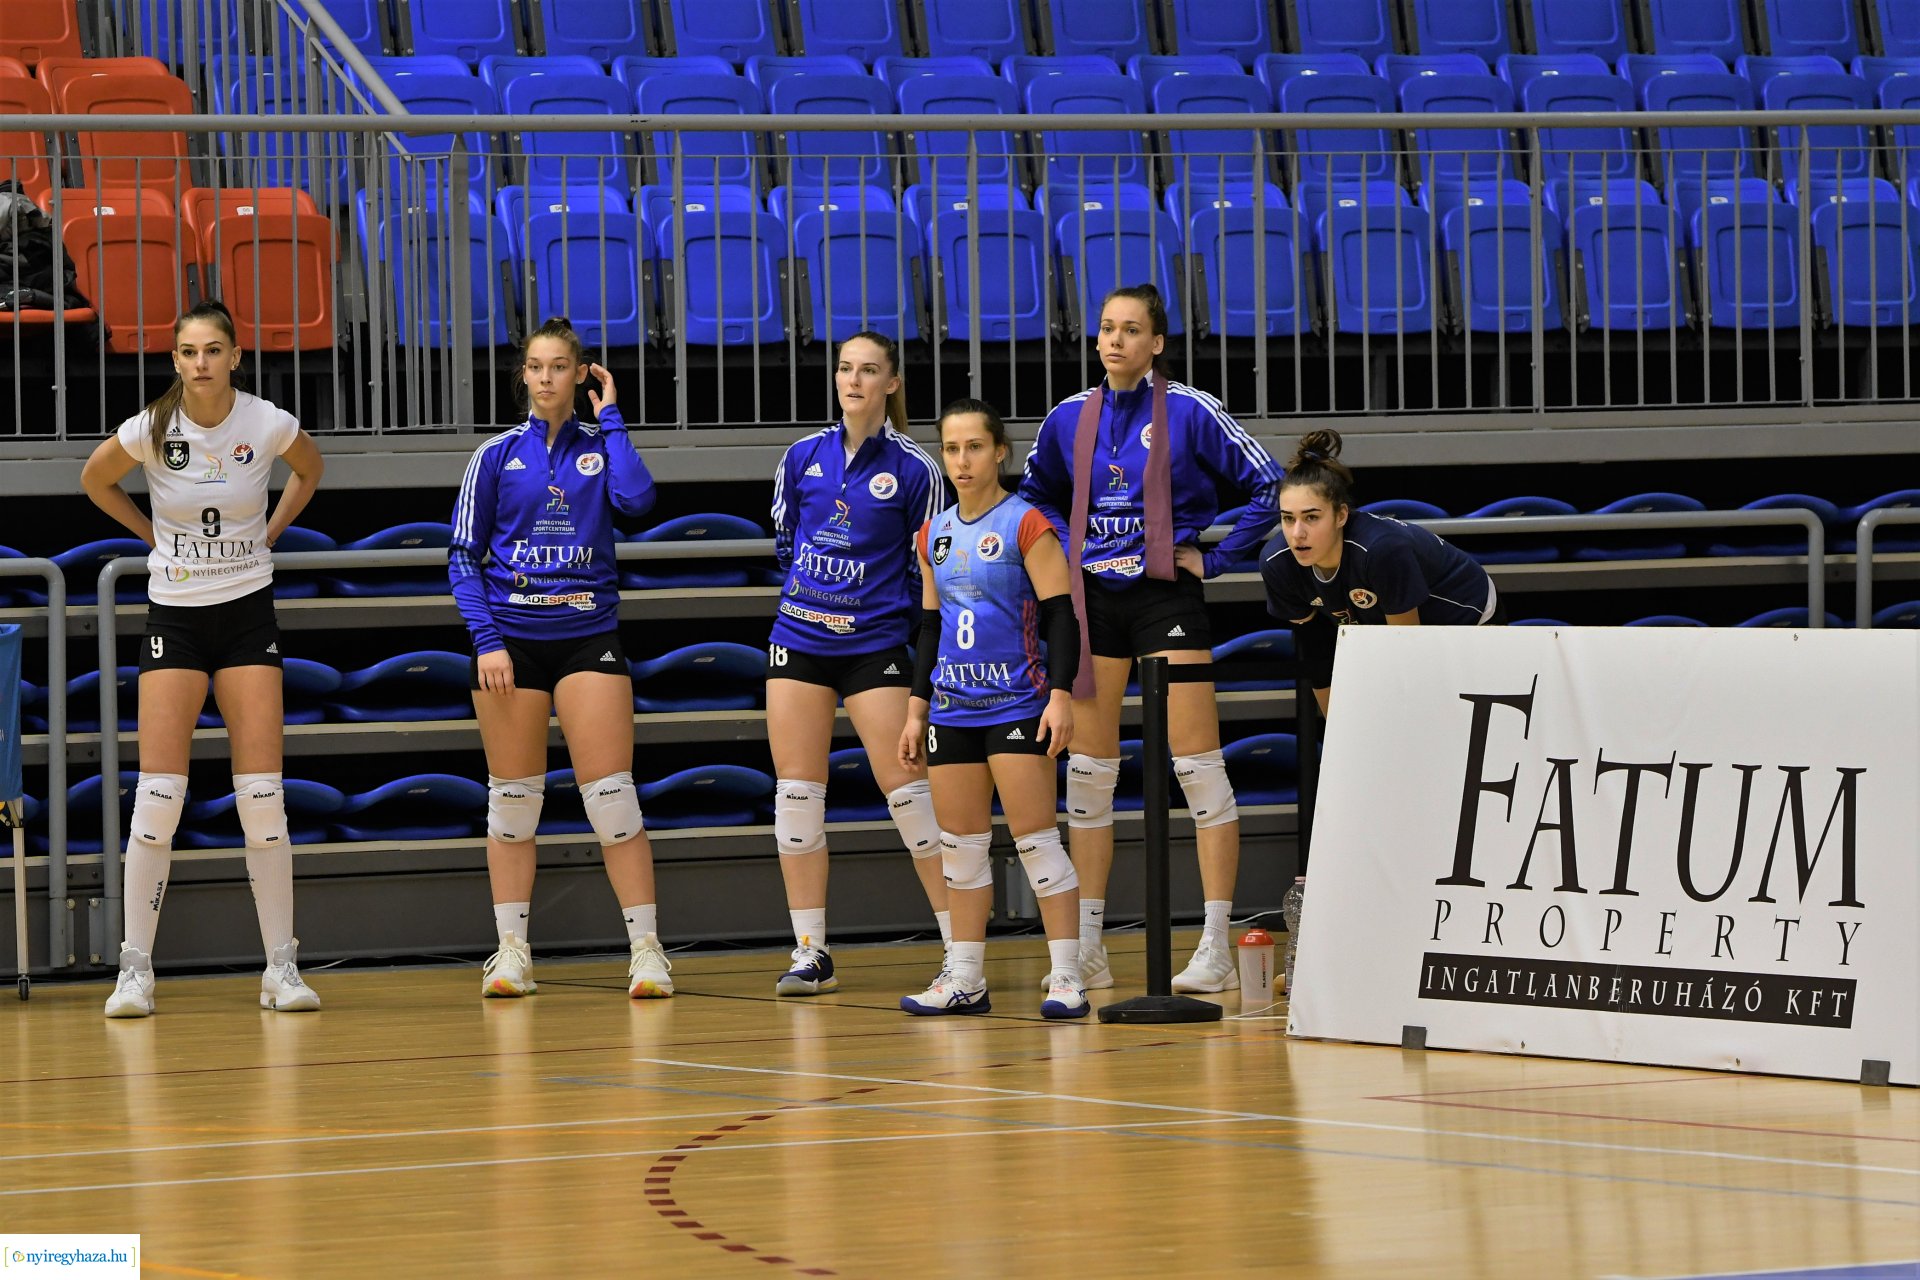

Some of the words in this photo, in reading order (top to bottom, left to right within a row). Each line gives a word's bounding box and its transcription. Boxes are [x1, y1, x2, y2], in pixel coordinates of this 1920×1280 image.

[201, 507, 221, 538] 9
[1089, 515, 1145, 535] ATUM
[172, 533, 253, 558] FATUM
[509, 538, 593, 563] FATUM
[193, 560, 259, 577] NYÍREGYHÁZA
[794, 542, 867, 580] FATUM
[1086, 557, 1136, 572] DESPORT
[797, 567, 864, 586] ROPERTY
[799, 585, 861, 606] NYÍREGYHÁZA
[782, 603, 849, 624] BLADESPORT
[957, 609, 975, 650] 8
[150, 636, 164, 659] 9
[770, 644, 788, 667] 18
[936, 655, 1011, 682] FATUM
[928, 725, 938, 753] 8
[150, 790, 172, 800] MIKASA
[1435, 673, 1867, 908] FATUM
[150, 880, 164, 911] MIKASA
[1430, 899, 1862, 966] PROPERTY
[1425, 965, 1763, 1012] INGATLANBERUHÁZÓ
[1785, 988, 1848, 1018] KFT
